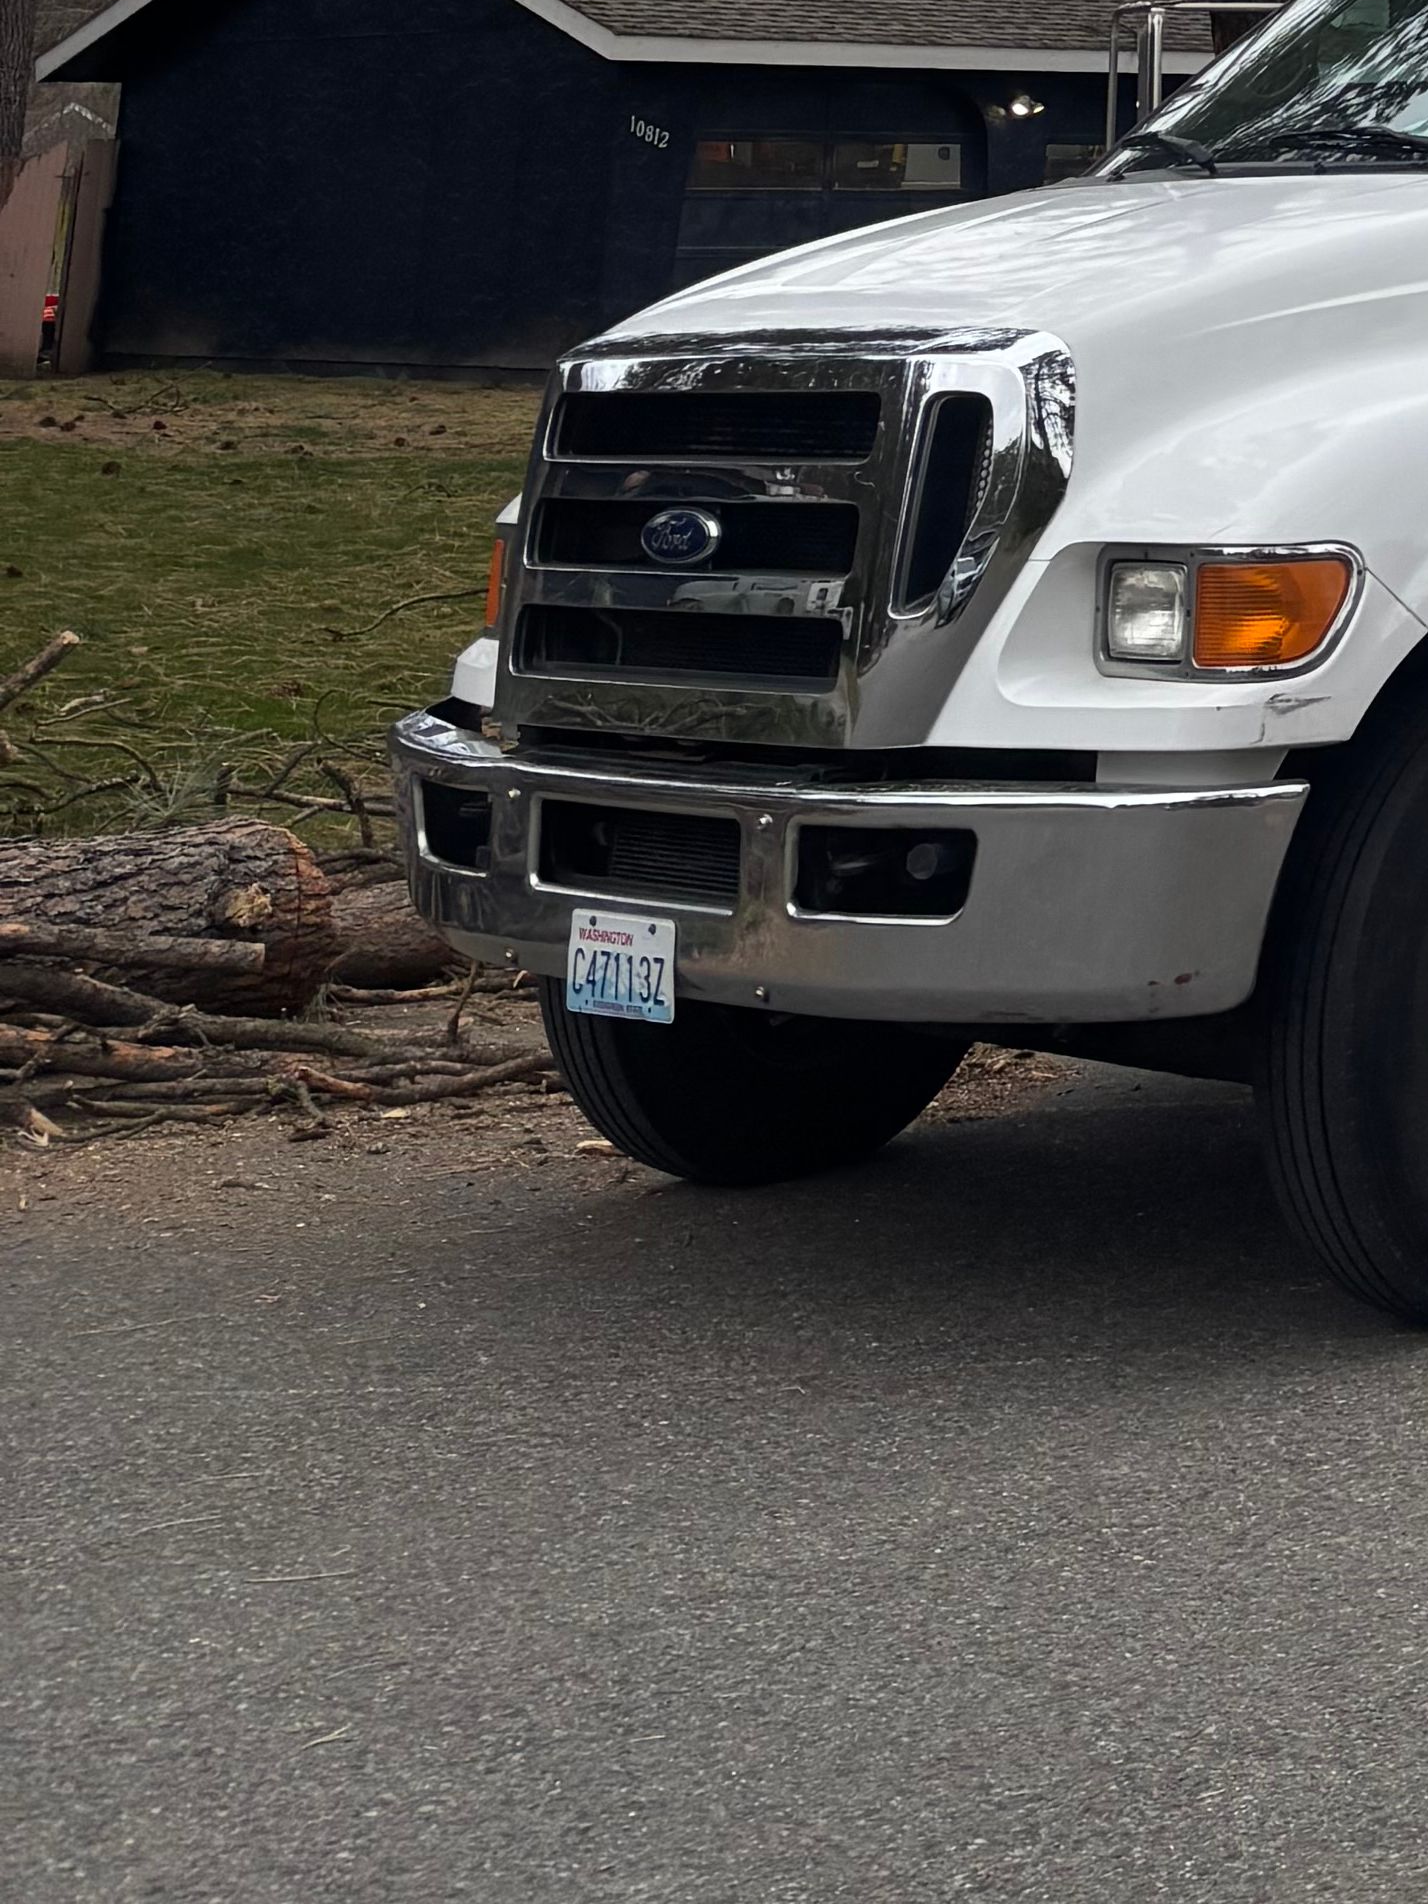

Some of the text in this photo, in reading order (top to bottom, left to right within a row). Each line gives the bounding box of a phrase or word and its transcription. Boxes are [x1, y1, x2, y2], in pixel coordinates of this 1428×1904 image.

[630, 115, 670, 148] 10812
[650, 517, 695, 550] Ford
[578, 927, 634, 947] WASHINGTON
[572, 947, 665, 1006] C47113Z
